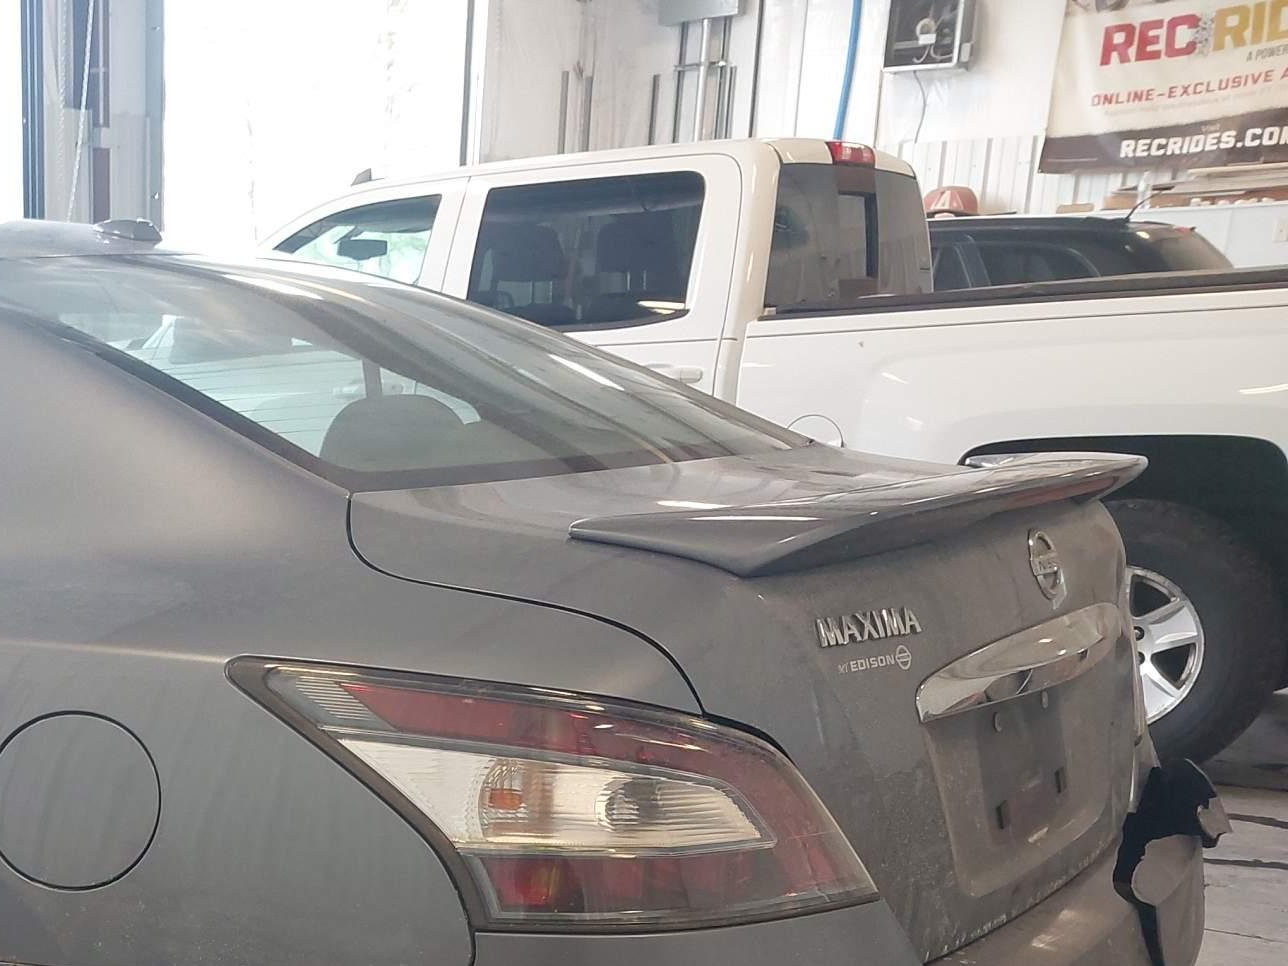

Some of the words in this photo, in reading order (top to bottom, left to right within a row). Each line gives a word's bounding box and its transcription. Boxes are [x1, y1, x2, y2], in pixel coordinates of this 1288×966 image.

[1099, 13, 1202, 66] REC
[1091, 69, 1274, 107] ONLINE-EXCLUSIVE
[815, 607, 922, 648] MAXIMA
[850, 654, 895, 672] EDISON
